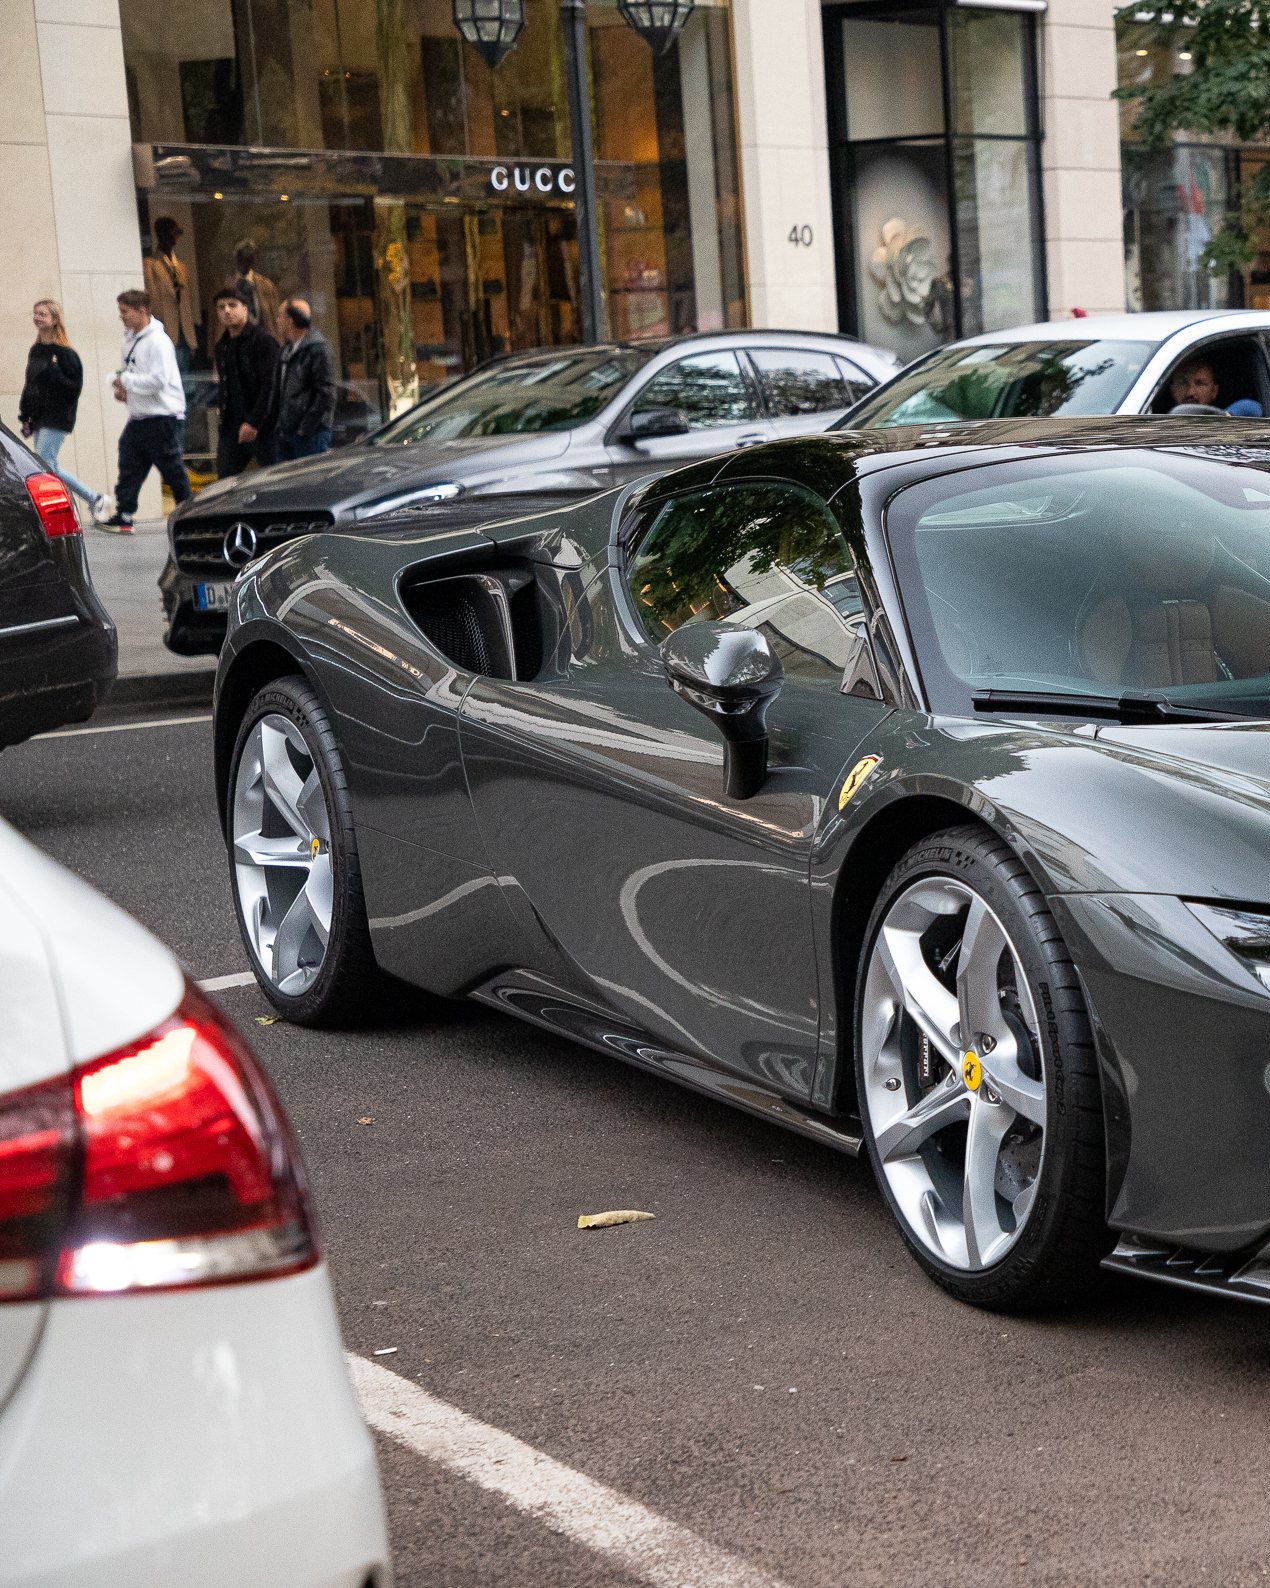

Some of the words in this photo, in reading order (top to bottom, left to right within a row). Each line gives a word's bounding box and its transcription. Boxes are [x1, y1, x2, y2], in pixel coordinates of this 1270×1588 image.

[490, 166, 576, 192] GUCC
[788, 224, 813, 247] 40
[905, 848, 953, 869] MICHELIN
